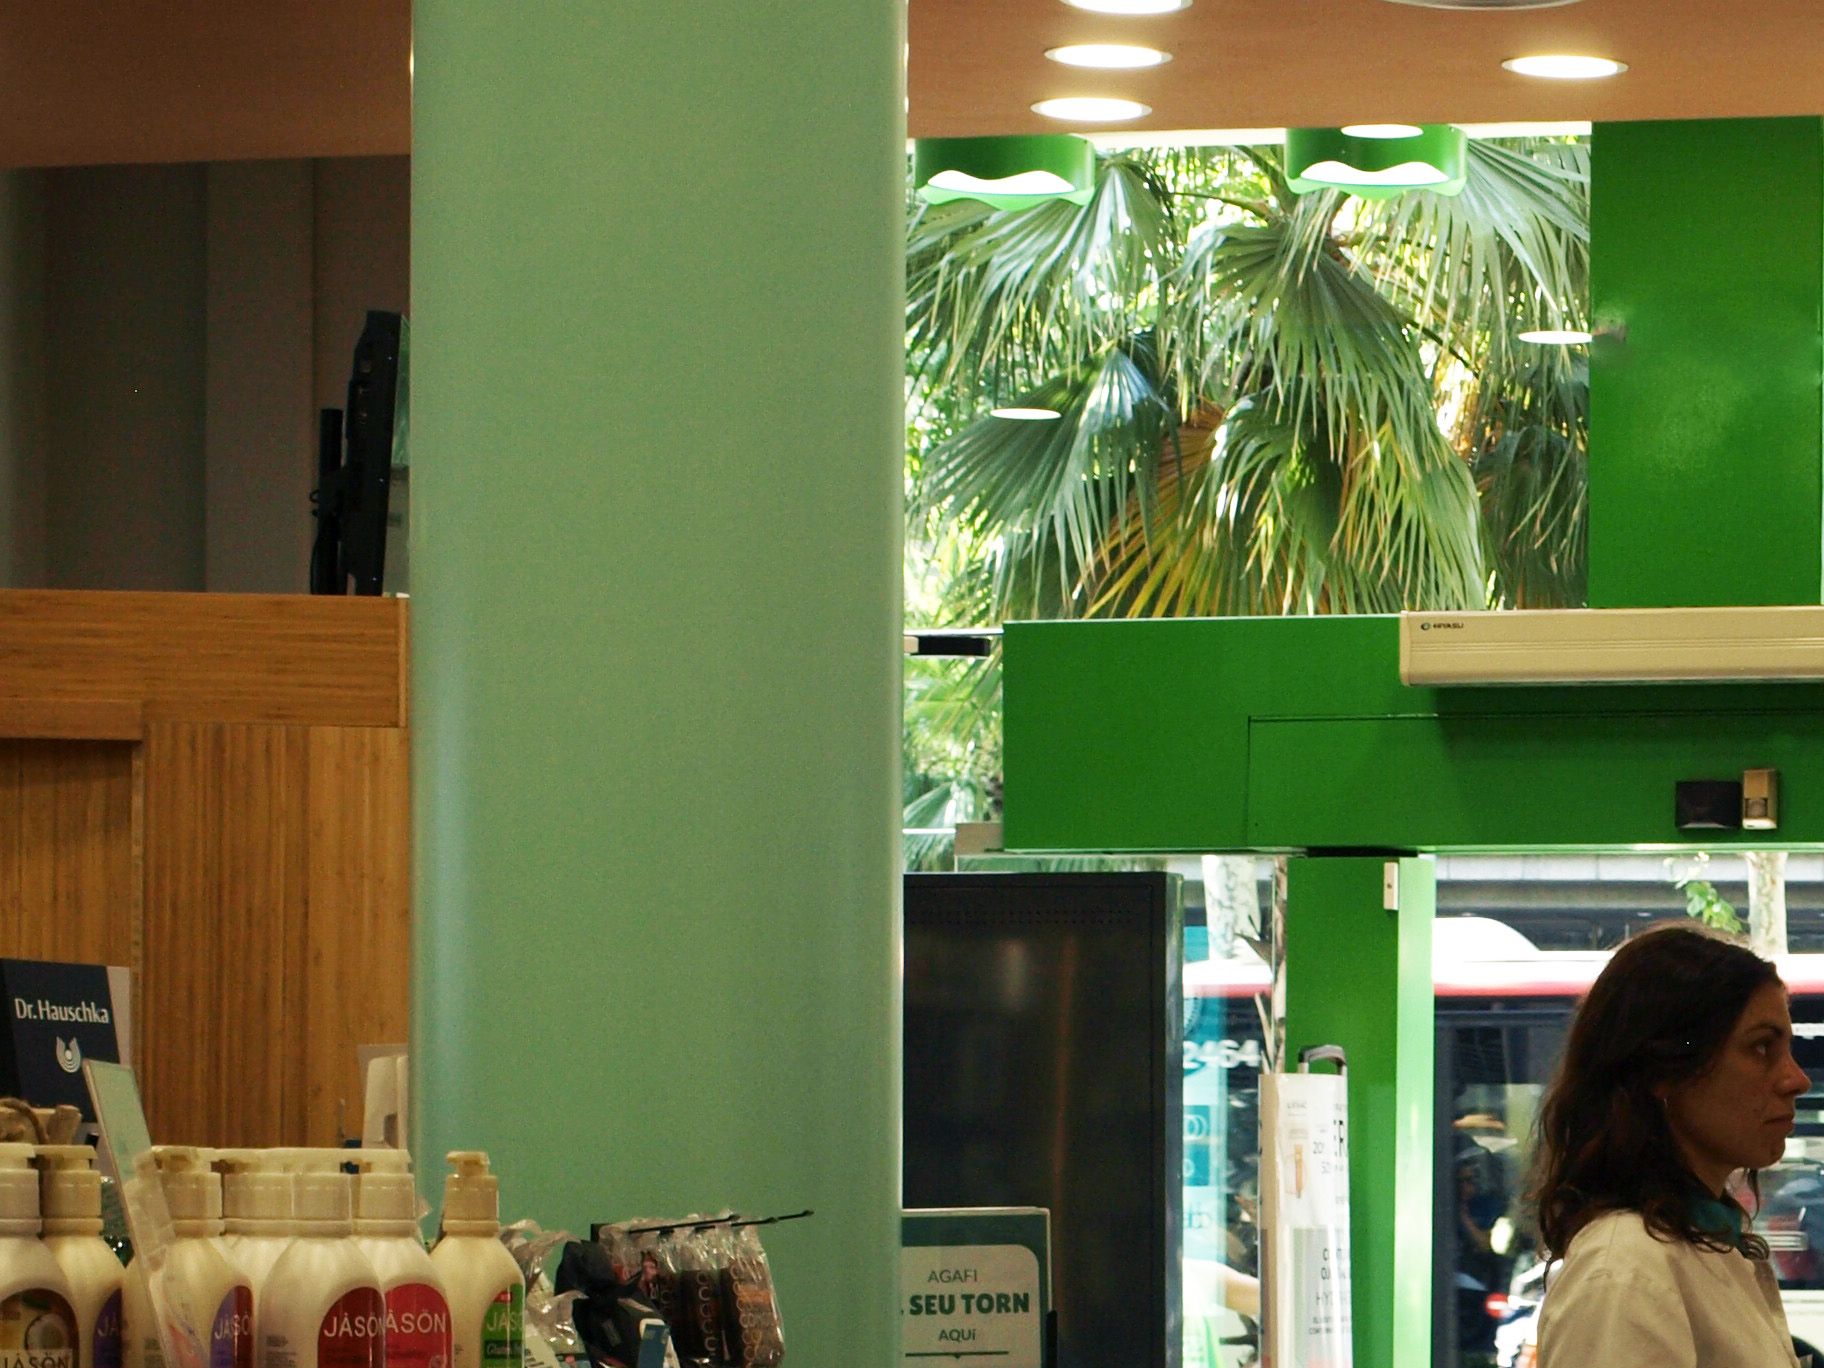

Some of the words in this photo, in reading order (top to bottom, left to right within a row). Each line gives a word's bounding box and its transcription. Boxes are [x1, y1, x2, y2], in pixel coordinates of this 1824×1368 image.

[927, 1269, 977, 1283] AGAFI
[909, 1294, 955, 1315] SEU
[962, 1292, 1030, 1314] TORN
